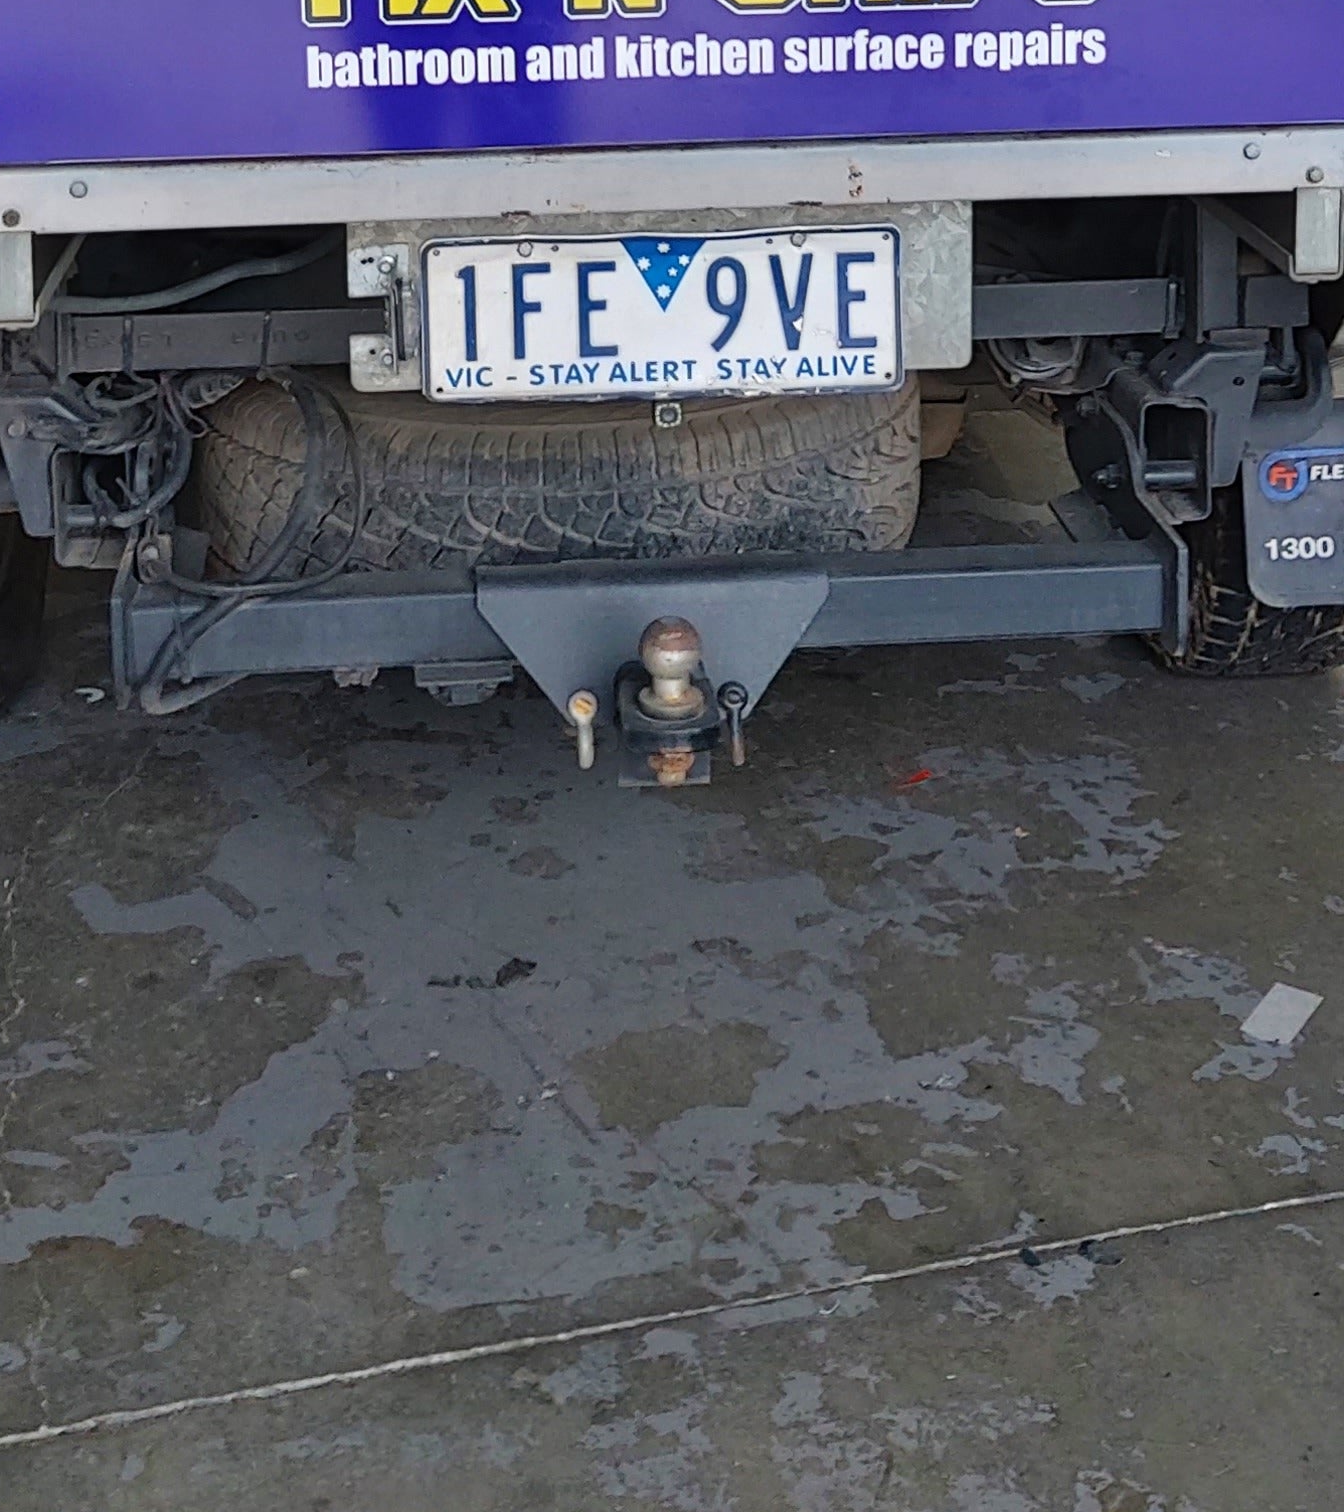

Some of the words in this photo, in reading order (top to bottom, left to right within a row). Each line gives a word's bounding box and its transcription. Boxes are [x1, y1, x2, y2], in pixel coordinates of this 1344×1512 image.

[306, 43, 516, 88] bathroom
[525, 36, 605, 82] and
[614, 32, 774, 79] kitchen
[784, 28, 945, 74] surface
[954, 23, 1107, 71] repairs
[456, 260, 619, 362] 1FE
[706, 251, 878, 352] 9VE
[446, 366, 493, 388] VIC
[529, 361, 600, 385] STAY
[608, 359, 697, 382] ALERT
[717, 356, 787, 380] STAY
[796, 354, 876, 378] ALIVE
[1264, 536, 1335, 561] 1300
